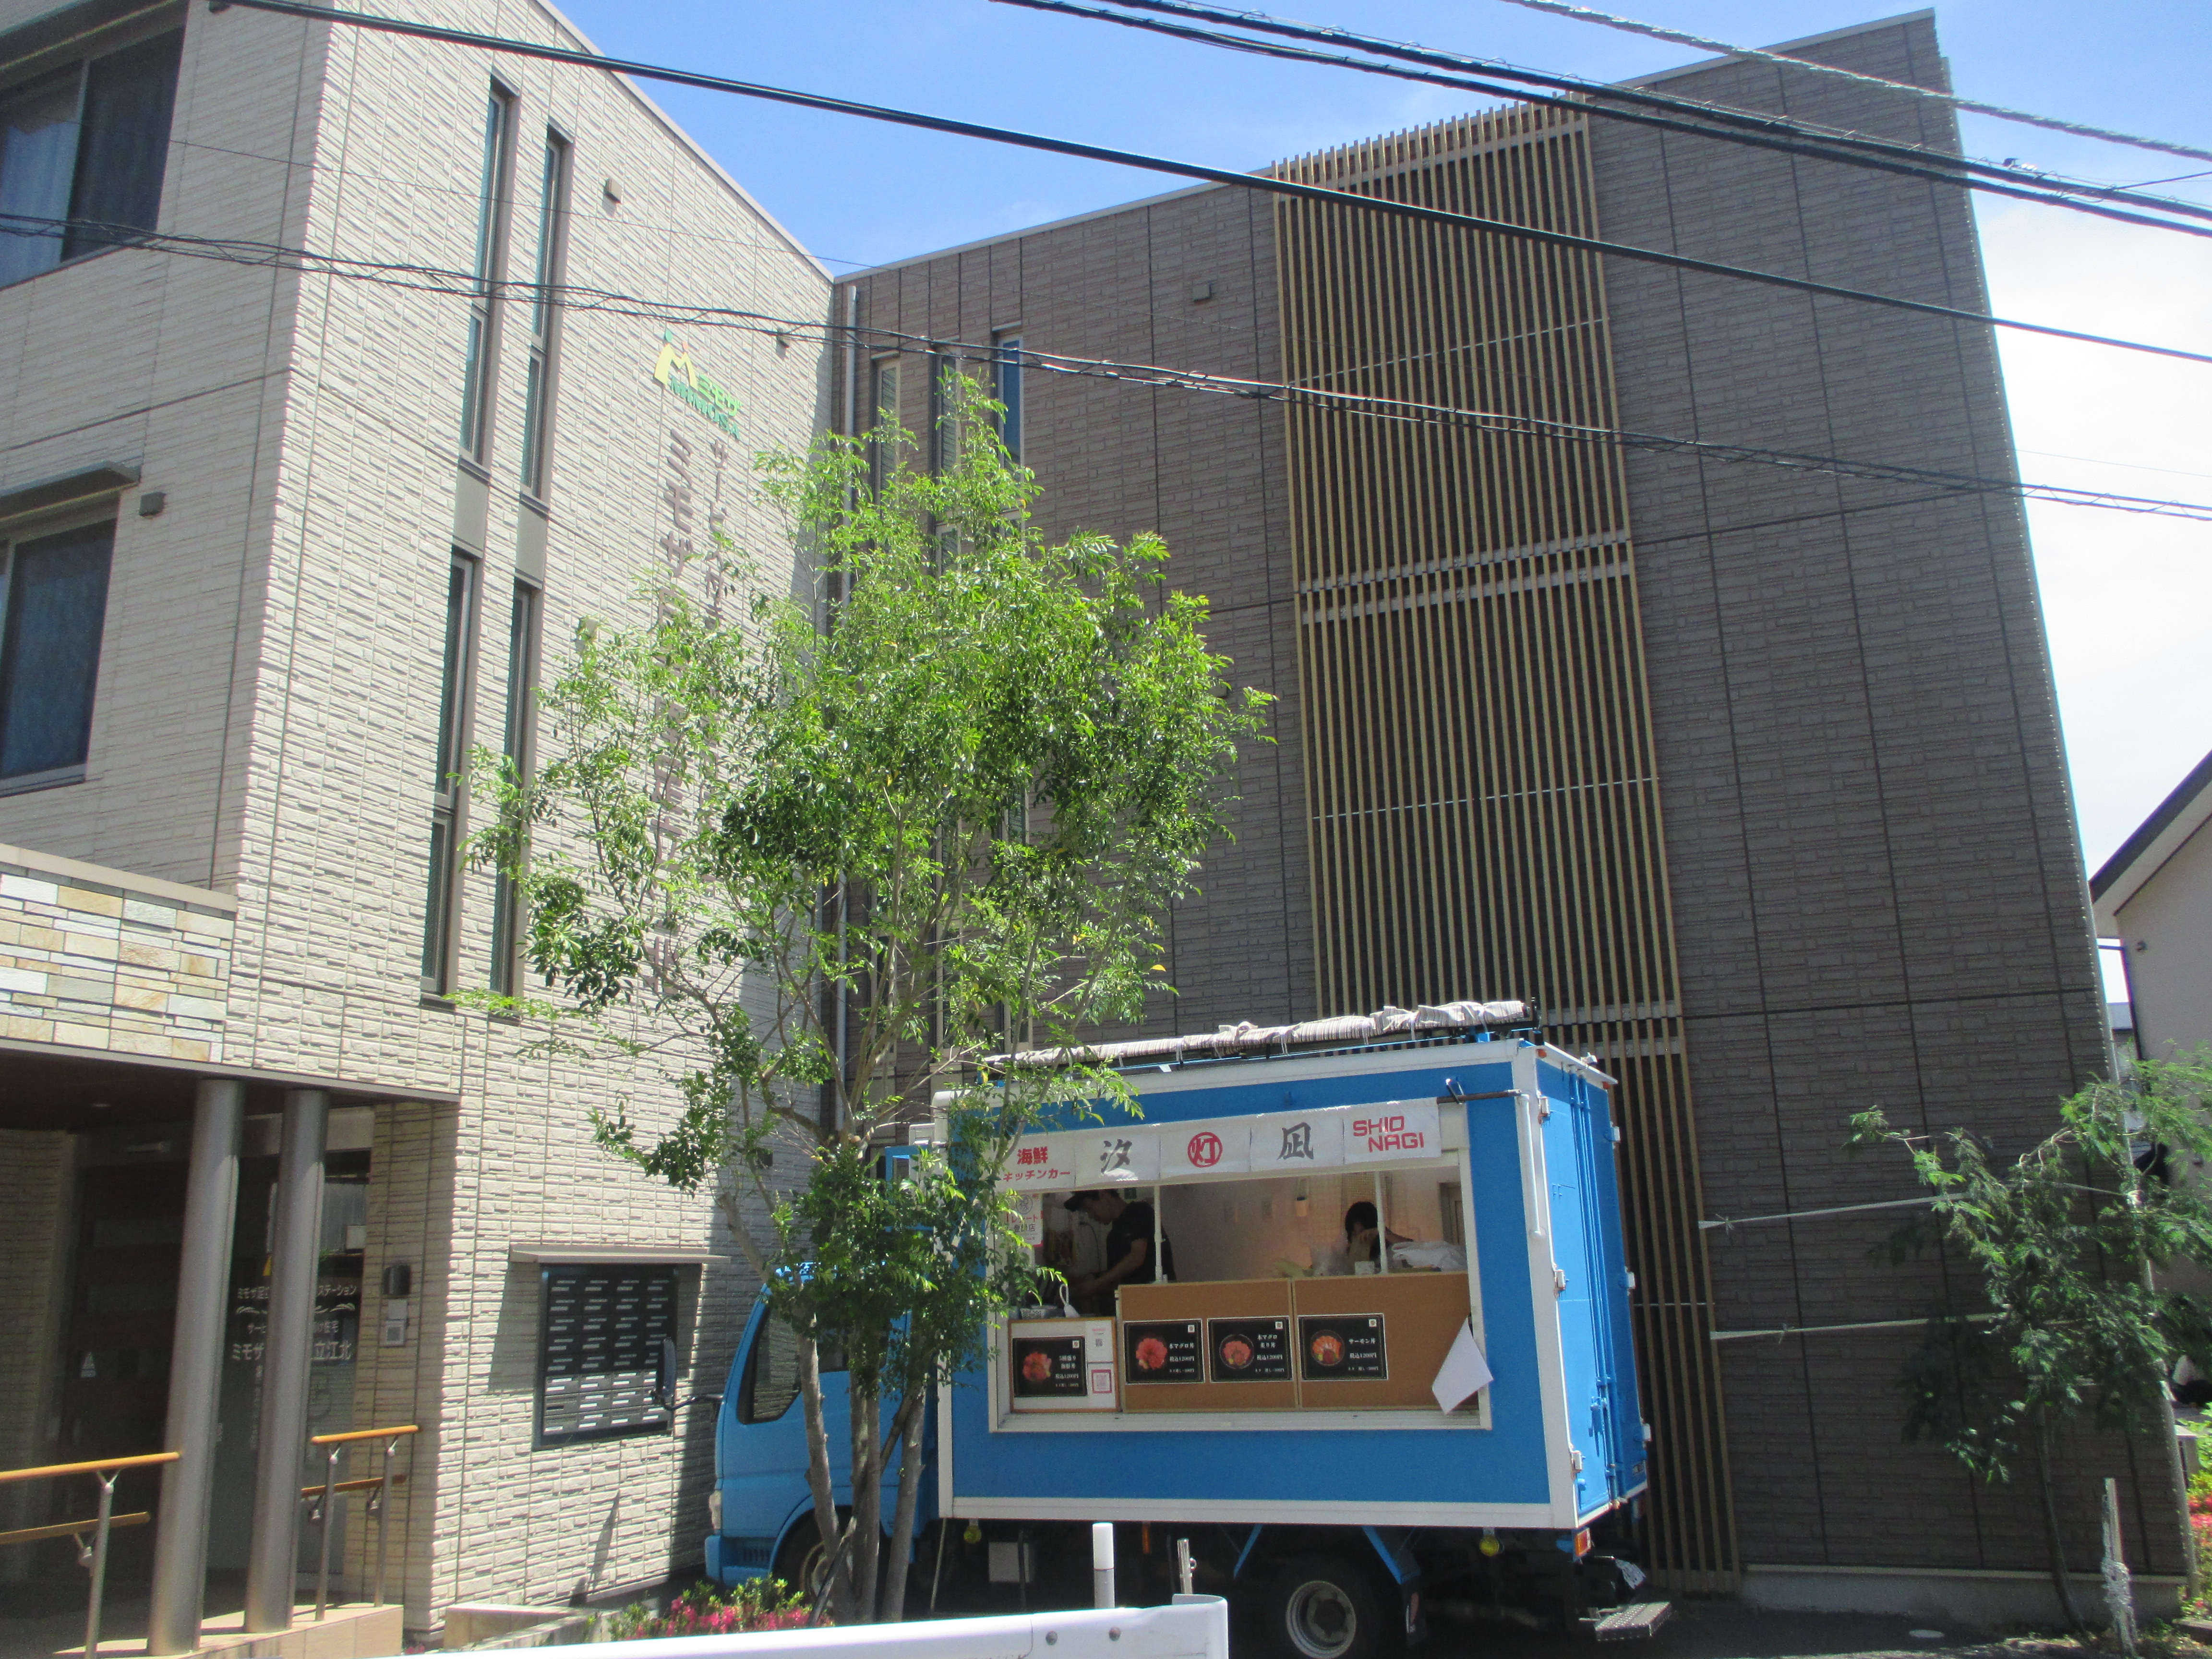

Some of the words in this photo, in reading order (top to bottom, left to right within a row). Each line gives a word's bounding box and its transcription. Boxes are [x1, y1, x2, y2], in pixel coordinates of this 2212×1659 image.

[698, 373, 743, 417] ミモザ
[671, 376, 741, 441] MIMOSA
[1353, 1116, 1405, 1136] SHIO
[1277, 1121, 1314, 1160] 凪
[1368, 1131, 1424, 1153] NAGI
[1017, 1146, 1048, 1165] 海鮮
[1003, 1168, 1071, 1182] キッチンカー
